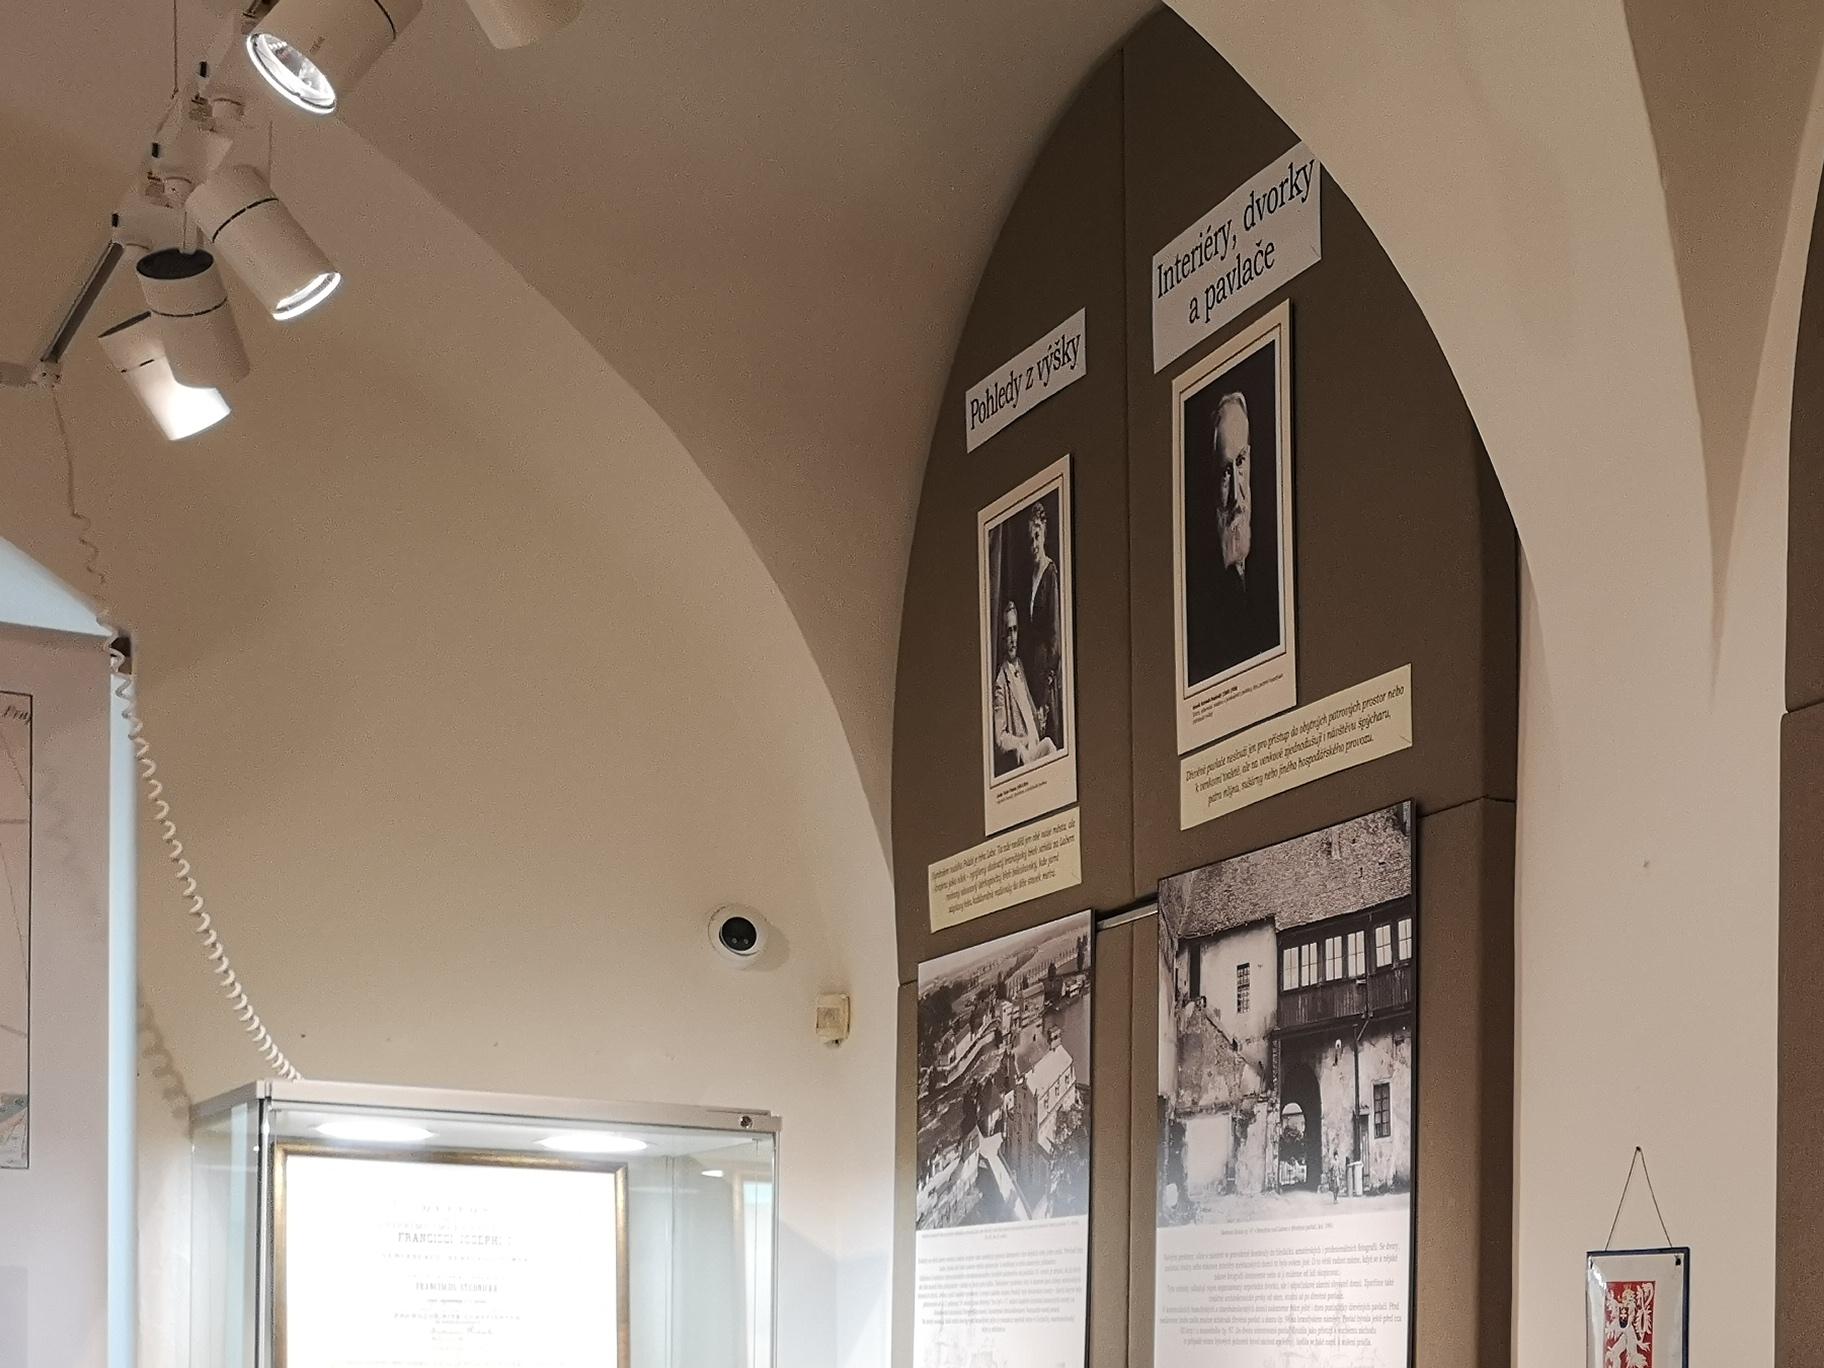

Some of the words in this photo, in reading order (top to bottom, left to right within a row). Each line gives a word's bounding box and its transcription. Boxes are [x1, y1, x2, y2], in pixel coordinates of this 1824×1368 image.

[1157, 218, 1237, 299] Interiéry,
[1243, 159, 1316, 232] dvorky
[1188, 296, 1201, 324] a
[1204, 239, 1275, 323] pavlače
[970, 369, 1023, 431] Pohledy
[1025, 366, 1034, 391] z
[1036, 334, 1081, 387] výšky
